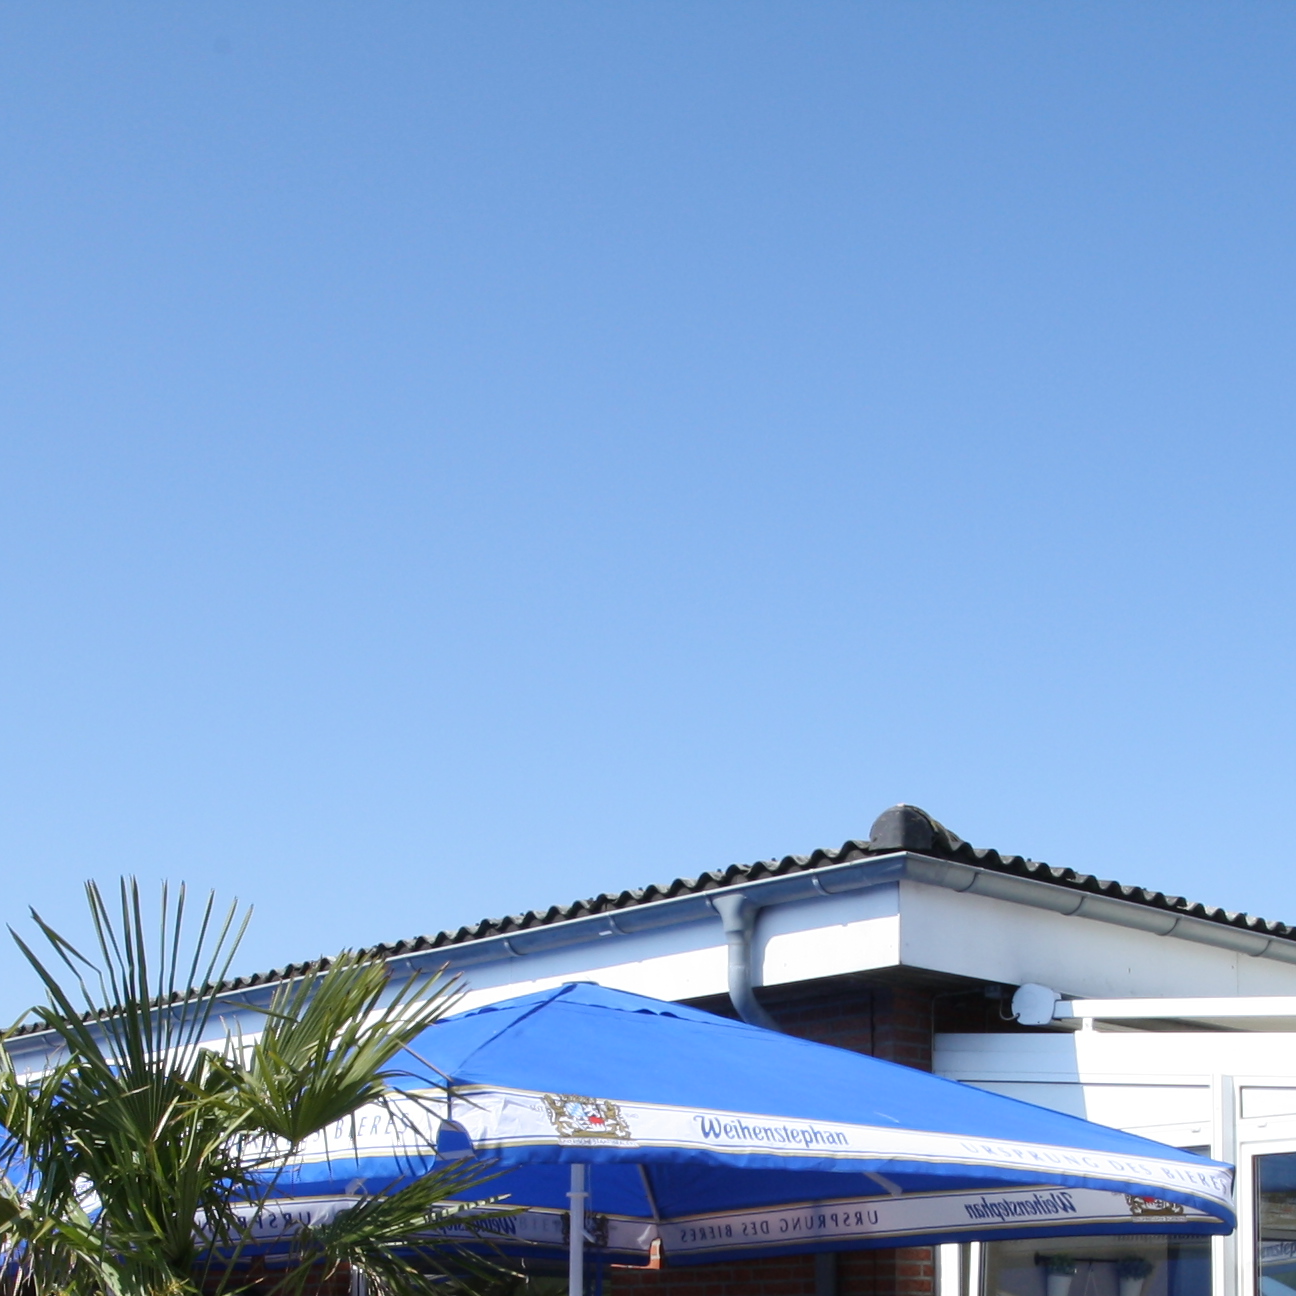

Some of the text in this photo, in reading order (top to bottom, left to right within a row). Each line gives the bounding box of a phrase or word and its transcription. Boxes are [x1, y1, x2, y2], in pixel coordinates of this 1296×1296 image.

[693, 1114, 849, 1148] Weihenstephan
[961, 1141, 1227, 1195] URSPRUNG DES BIERES
